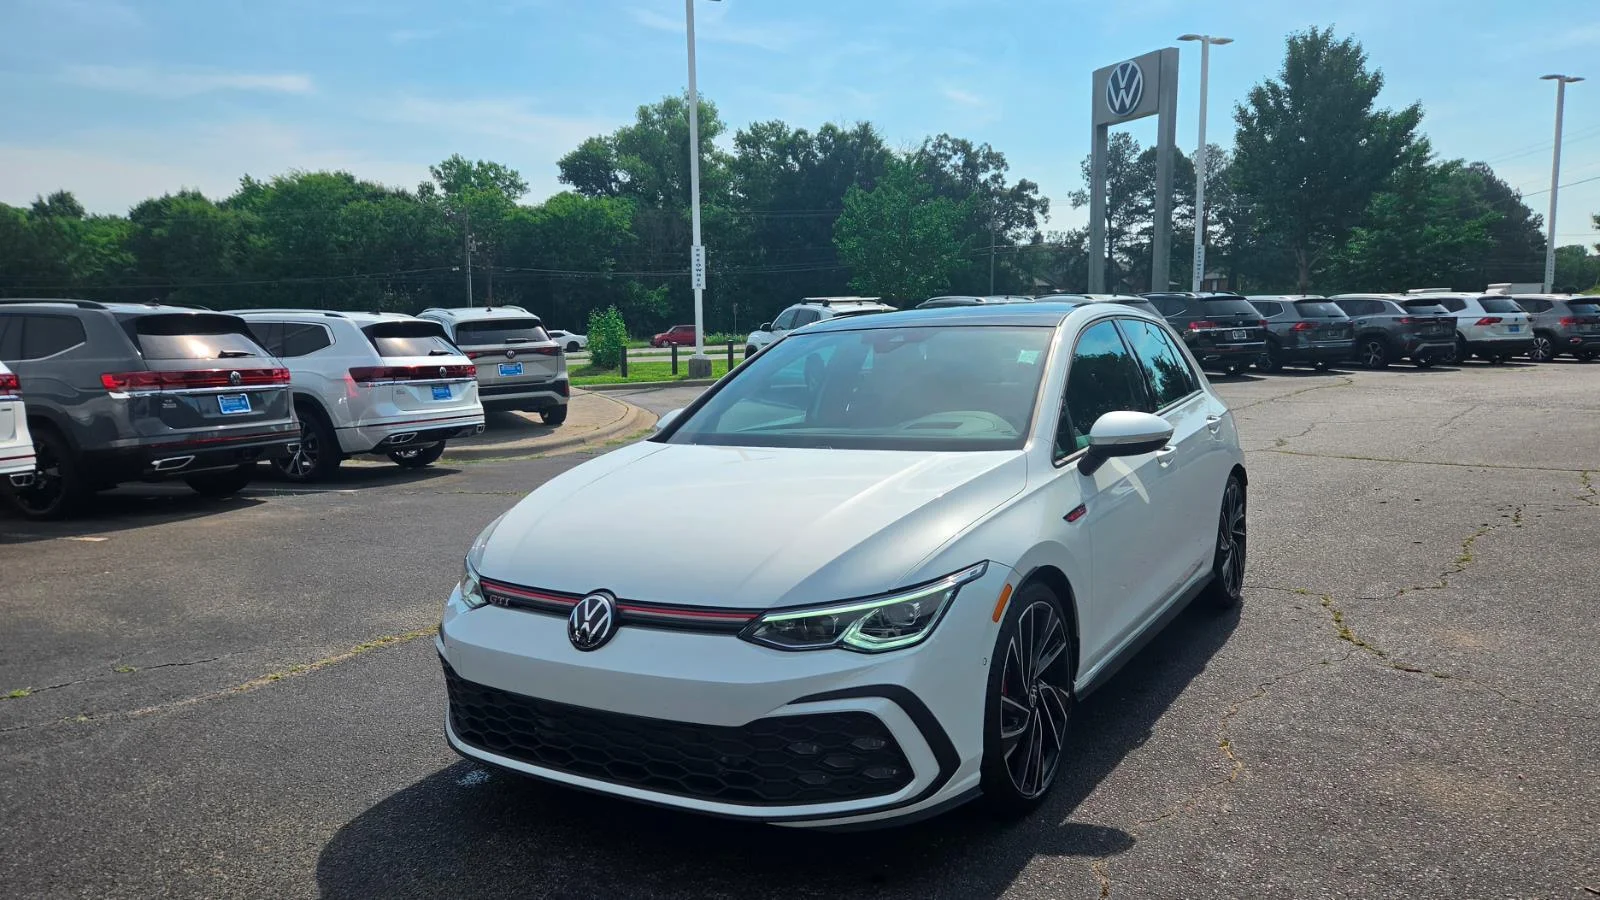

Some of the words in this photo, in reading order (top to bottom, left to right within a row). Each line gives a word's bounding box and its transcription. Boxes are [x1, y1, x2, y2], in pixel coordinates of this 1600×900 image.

[1107, 61, 1142, 113] VW
[490, 594, 510, 606] GTI
[571, 596, 610, 645] VW
